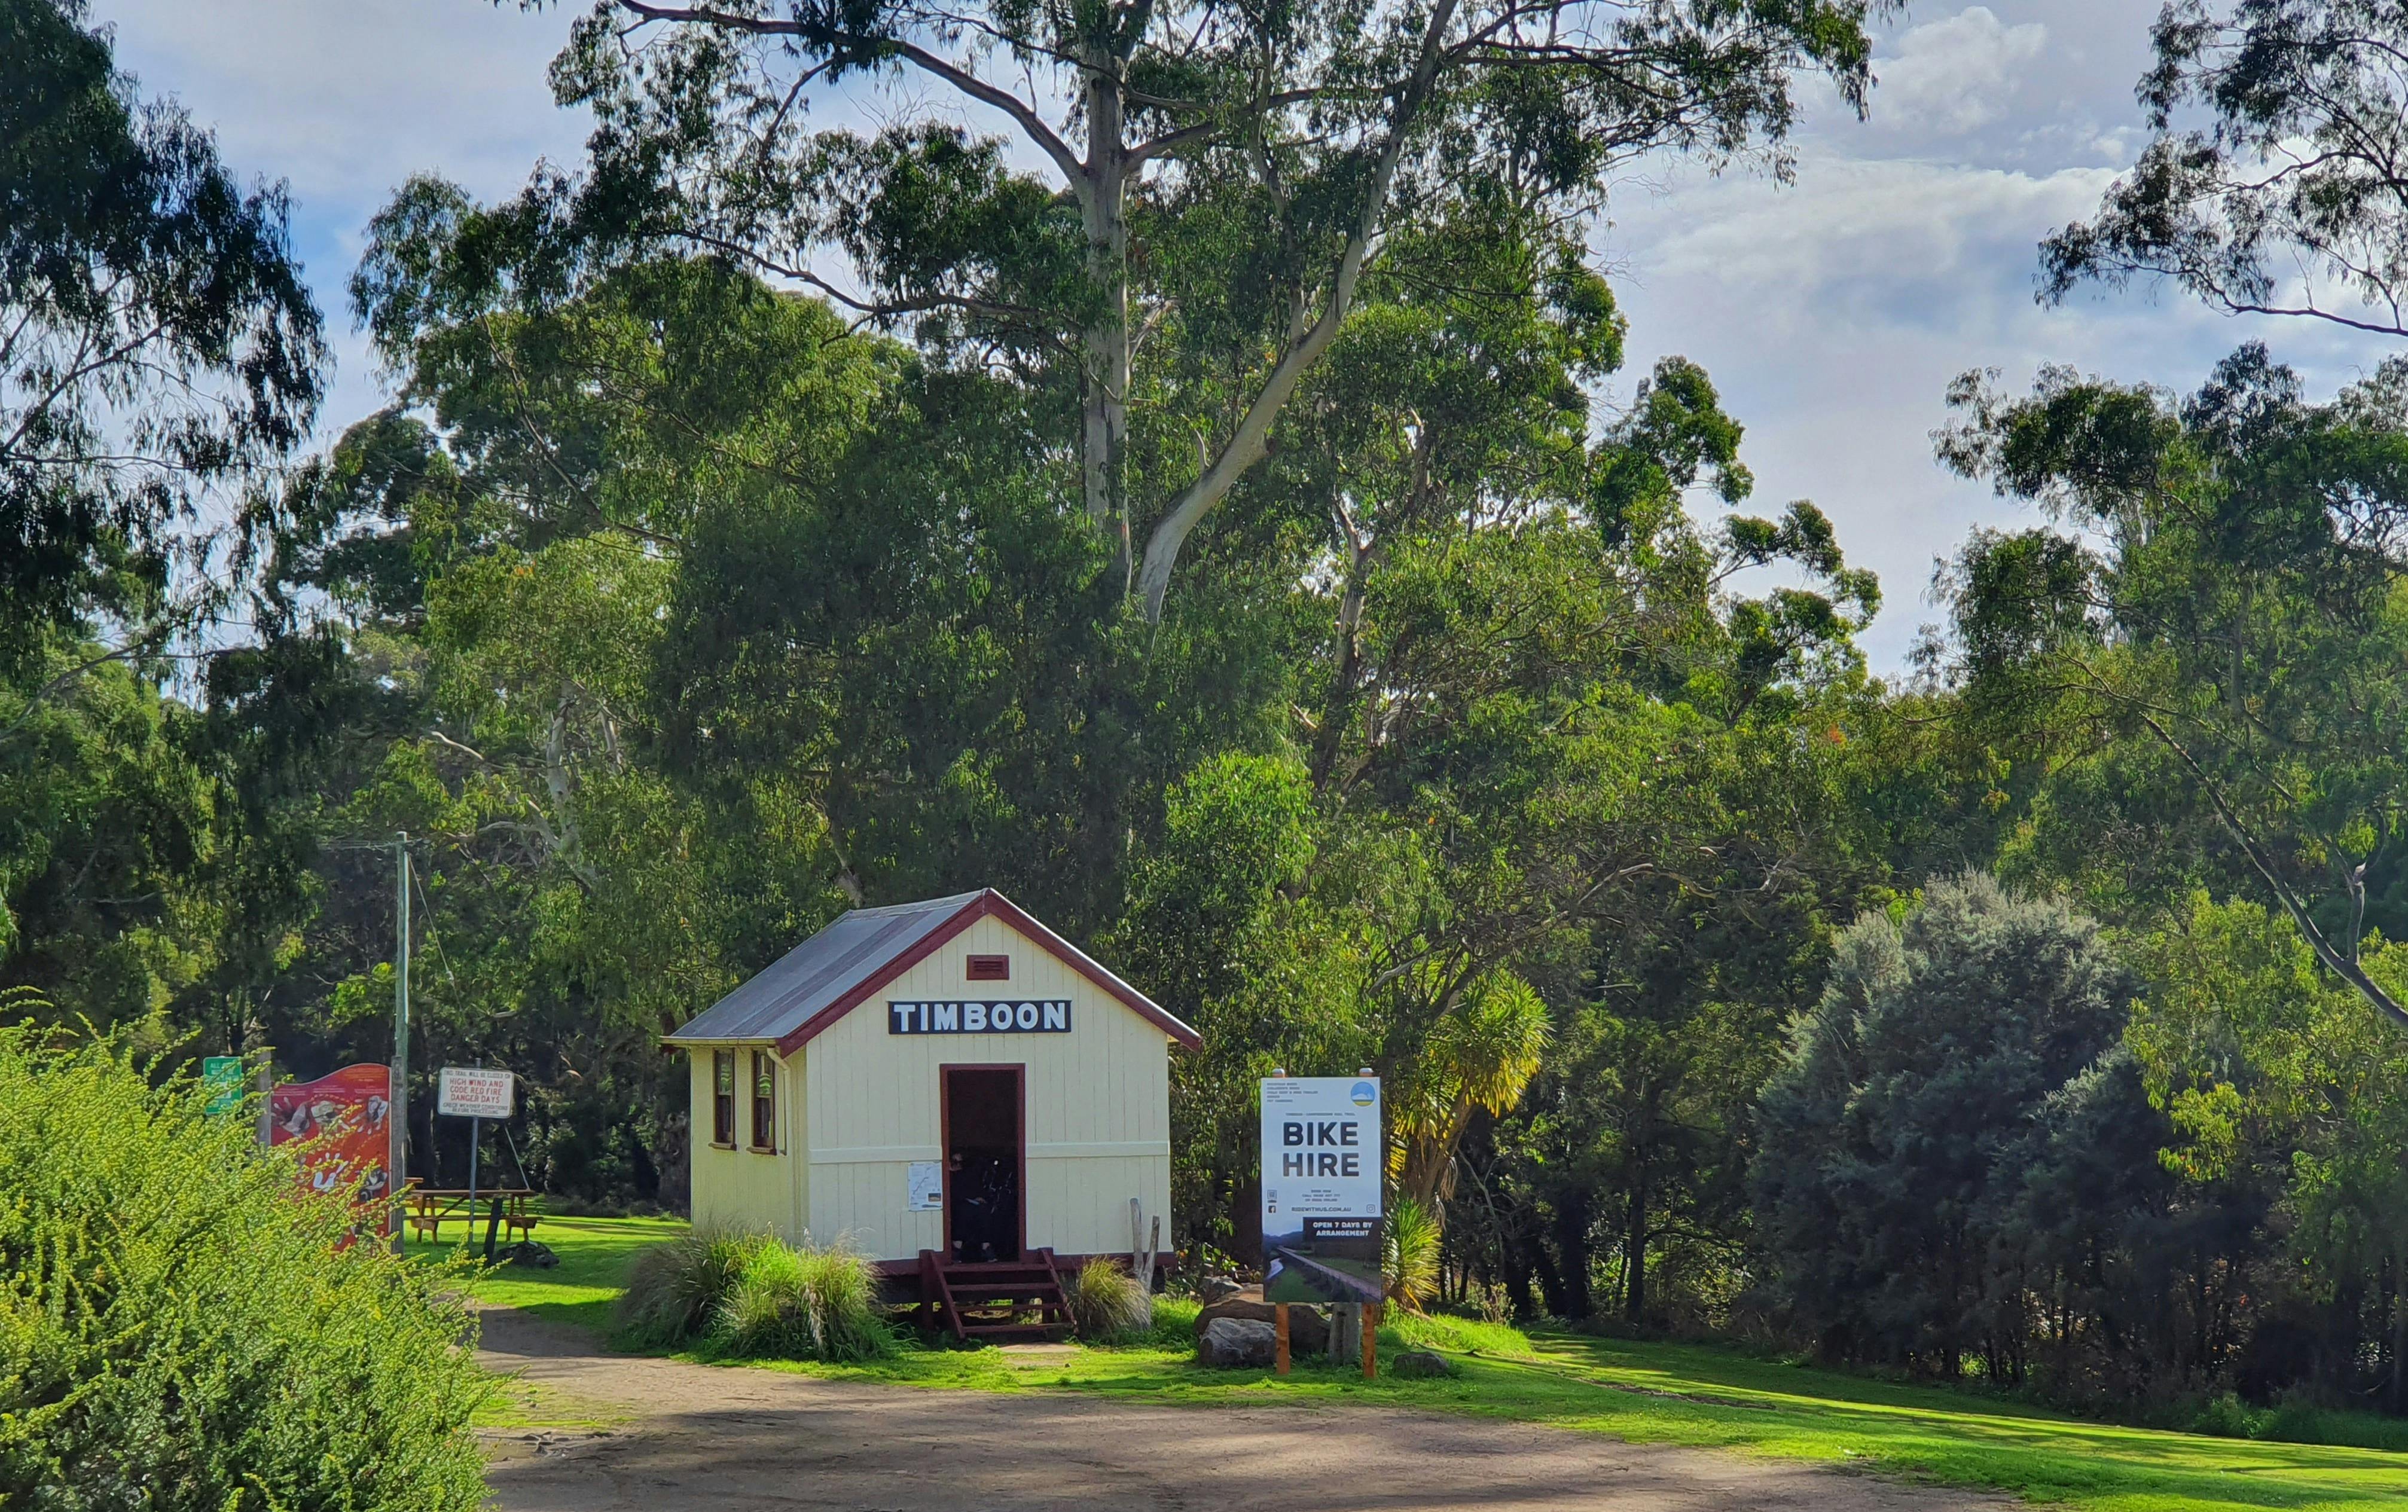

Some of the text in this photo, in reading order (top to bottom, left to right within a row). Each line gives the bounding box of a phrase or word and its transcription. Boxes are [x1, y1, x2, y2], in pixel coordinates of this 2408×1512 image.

[894, 1003, 1066, 1032] TIMBOON
[451, 1093, 500, 1104] DANGER DAYS
[1283, 1122, 1359, 1146] BIKE
[1283, 1153, 1359, 1177] HIRE
